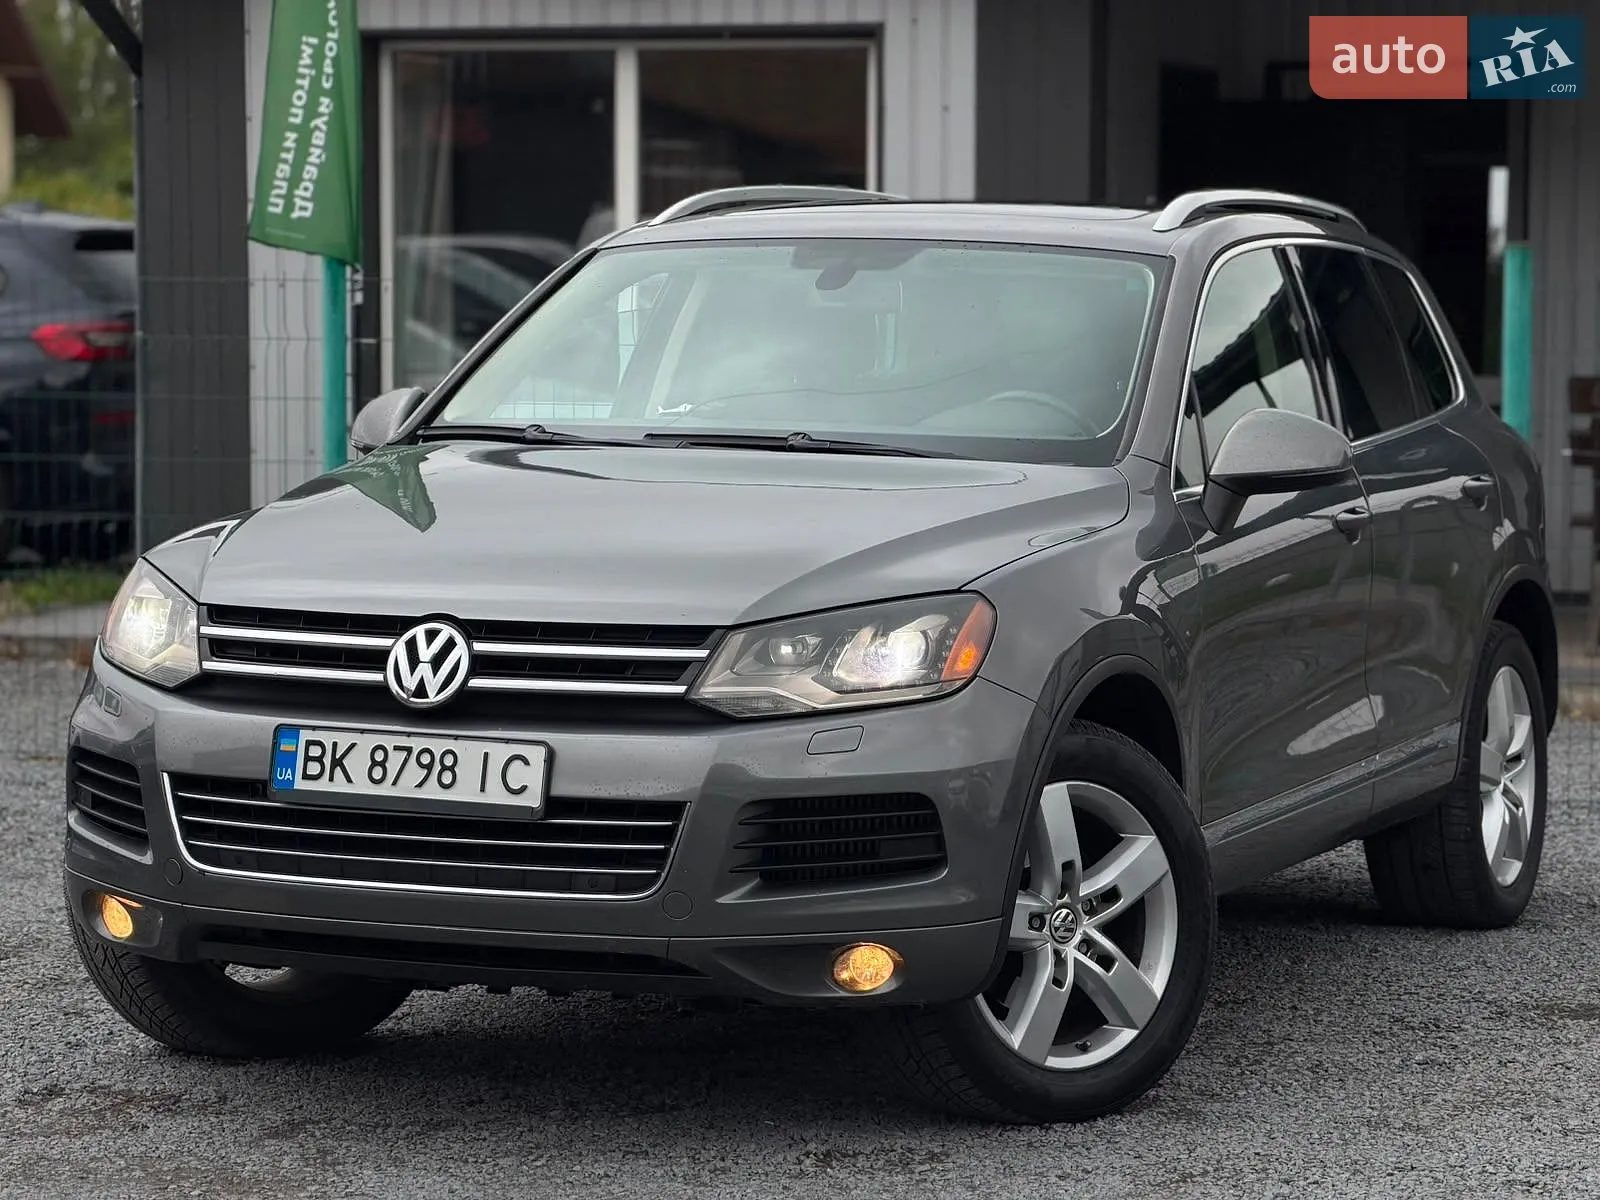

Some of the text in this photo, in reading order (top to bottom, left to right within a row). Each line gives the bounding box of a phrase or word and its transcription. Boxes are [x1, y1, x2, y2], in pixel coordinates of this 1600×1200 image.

[390, 623, 468, 704] VW
[276, 767, 293, 781] UA
[301, 739, 530, 795] BK 8798 IC
